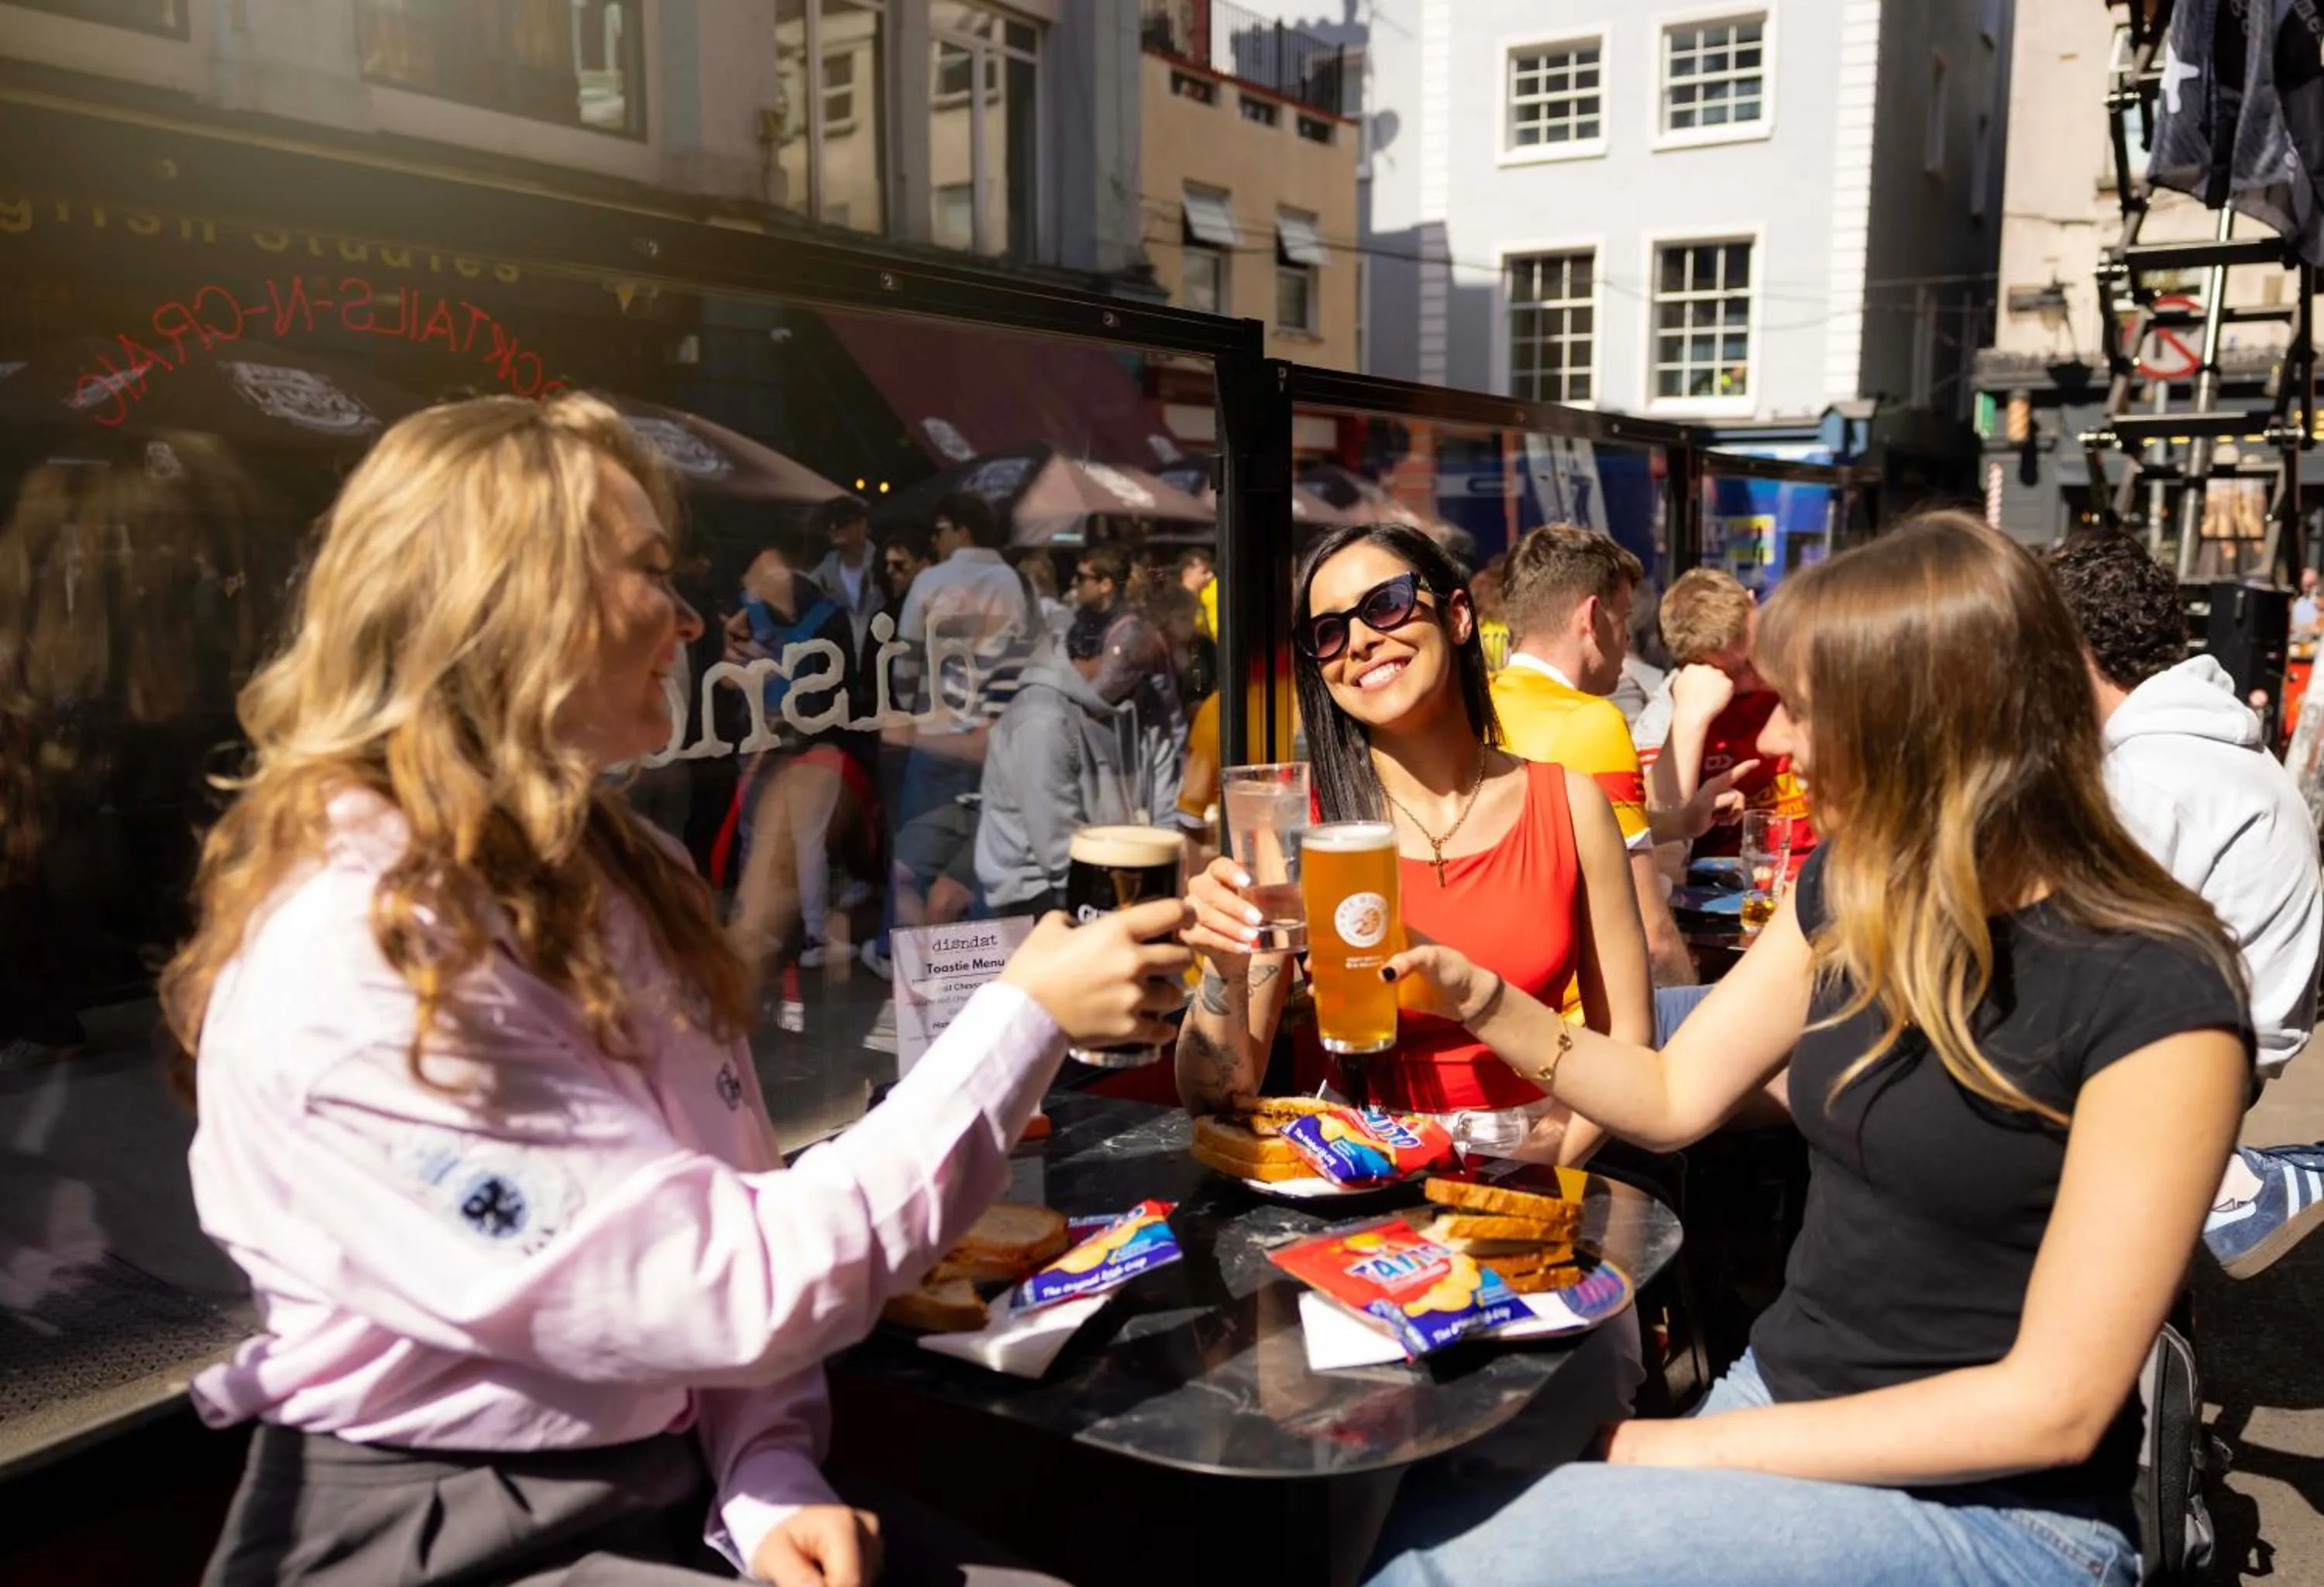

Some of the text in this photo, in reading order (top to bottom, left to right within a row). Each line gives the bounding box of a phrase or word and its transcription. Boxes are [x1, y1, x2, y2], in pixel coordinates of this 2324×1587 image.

[932, 935, 999, 952] disndat
[926, 959, 1006, 974] Toastie Menu
